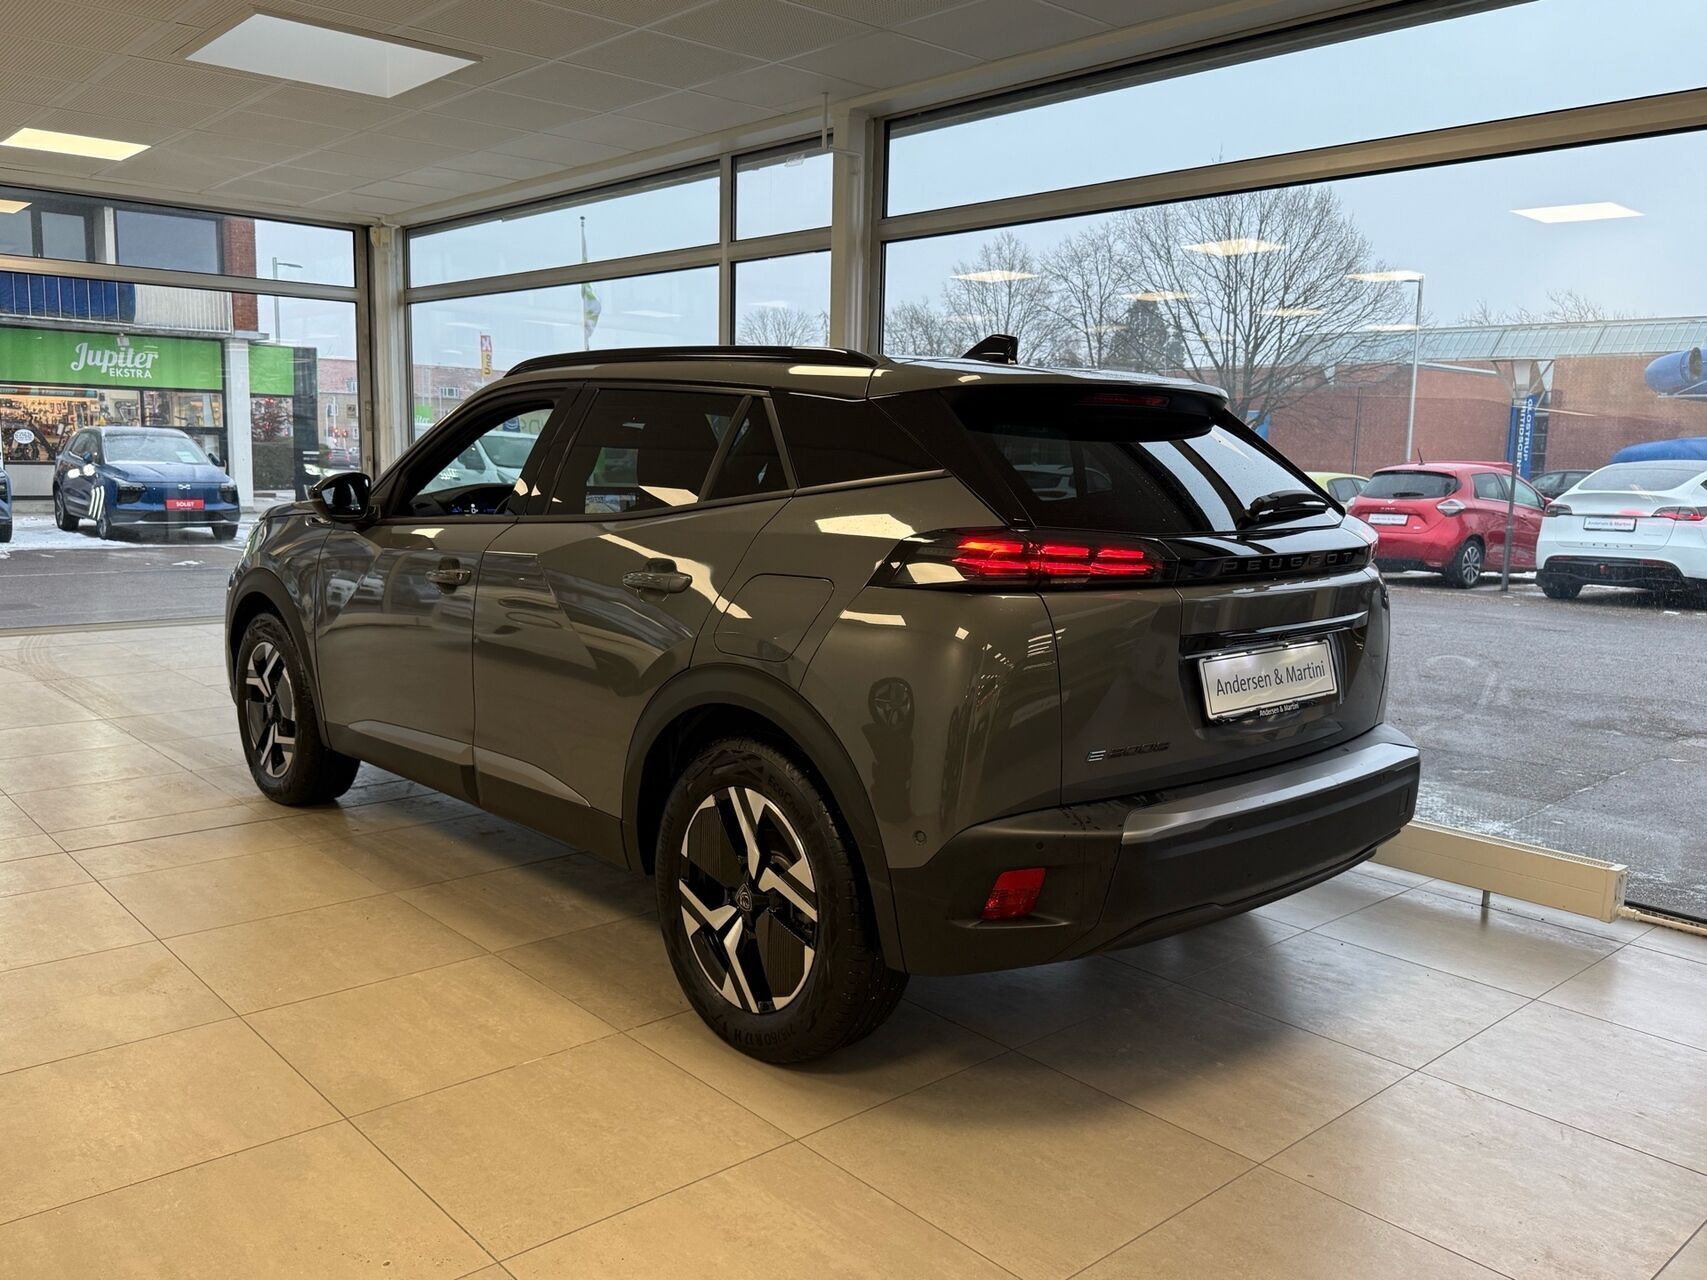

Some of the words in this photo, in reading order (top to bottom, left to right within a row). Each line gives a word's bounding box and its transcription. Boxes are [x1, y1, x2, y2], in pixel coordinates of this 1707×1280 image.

[70, 342, 159, 374] Jupiter
[109, 368, 153, 379] EKSTRA
[1221, 552, 1354, 574] PEUGEOT
[1216, 675, 1272, 697] Andersen
[1274, 668, 1284, 686] &
[1286, 660, 1326, 684] Martini
[1259, 707, 1280, 718] Andersen
